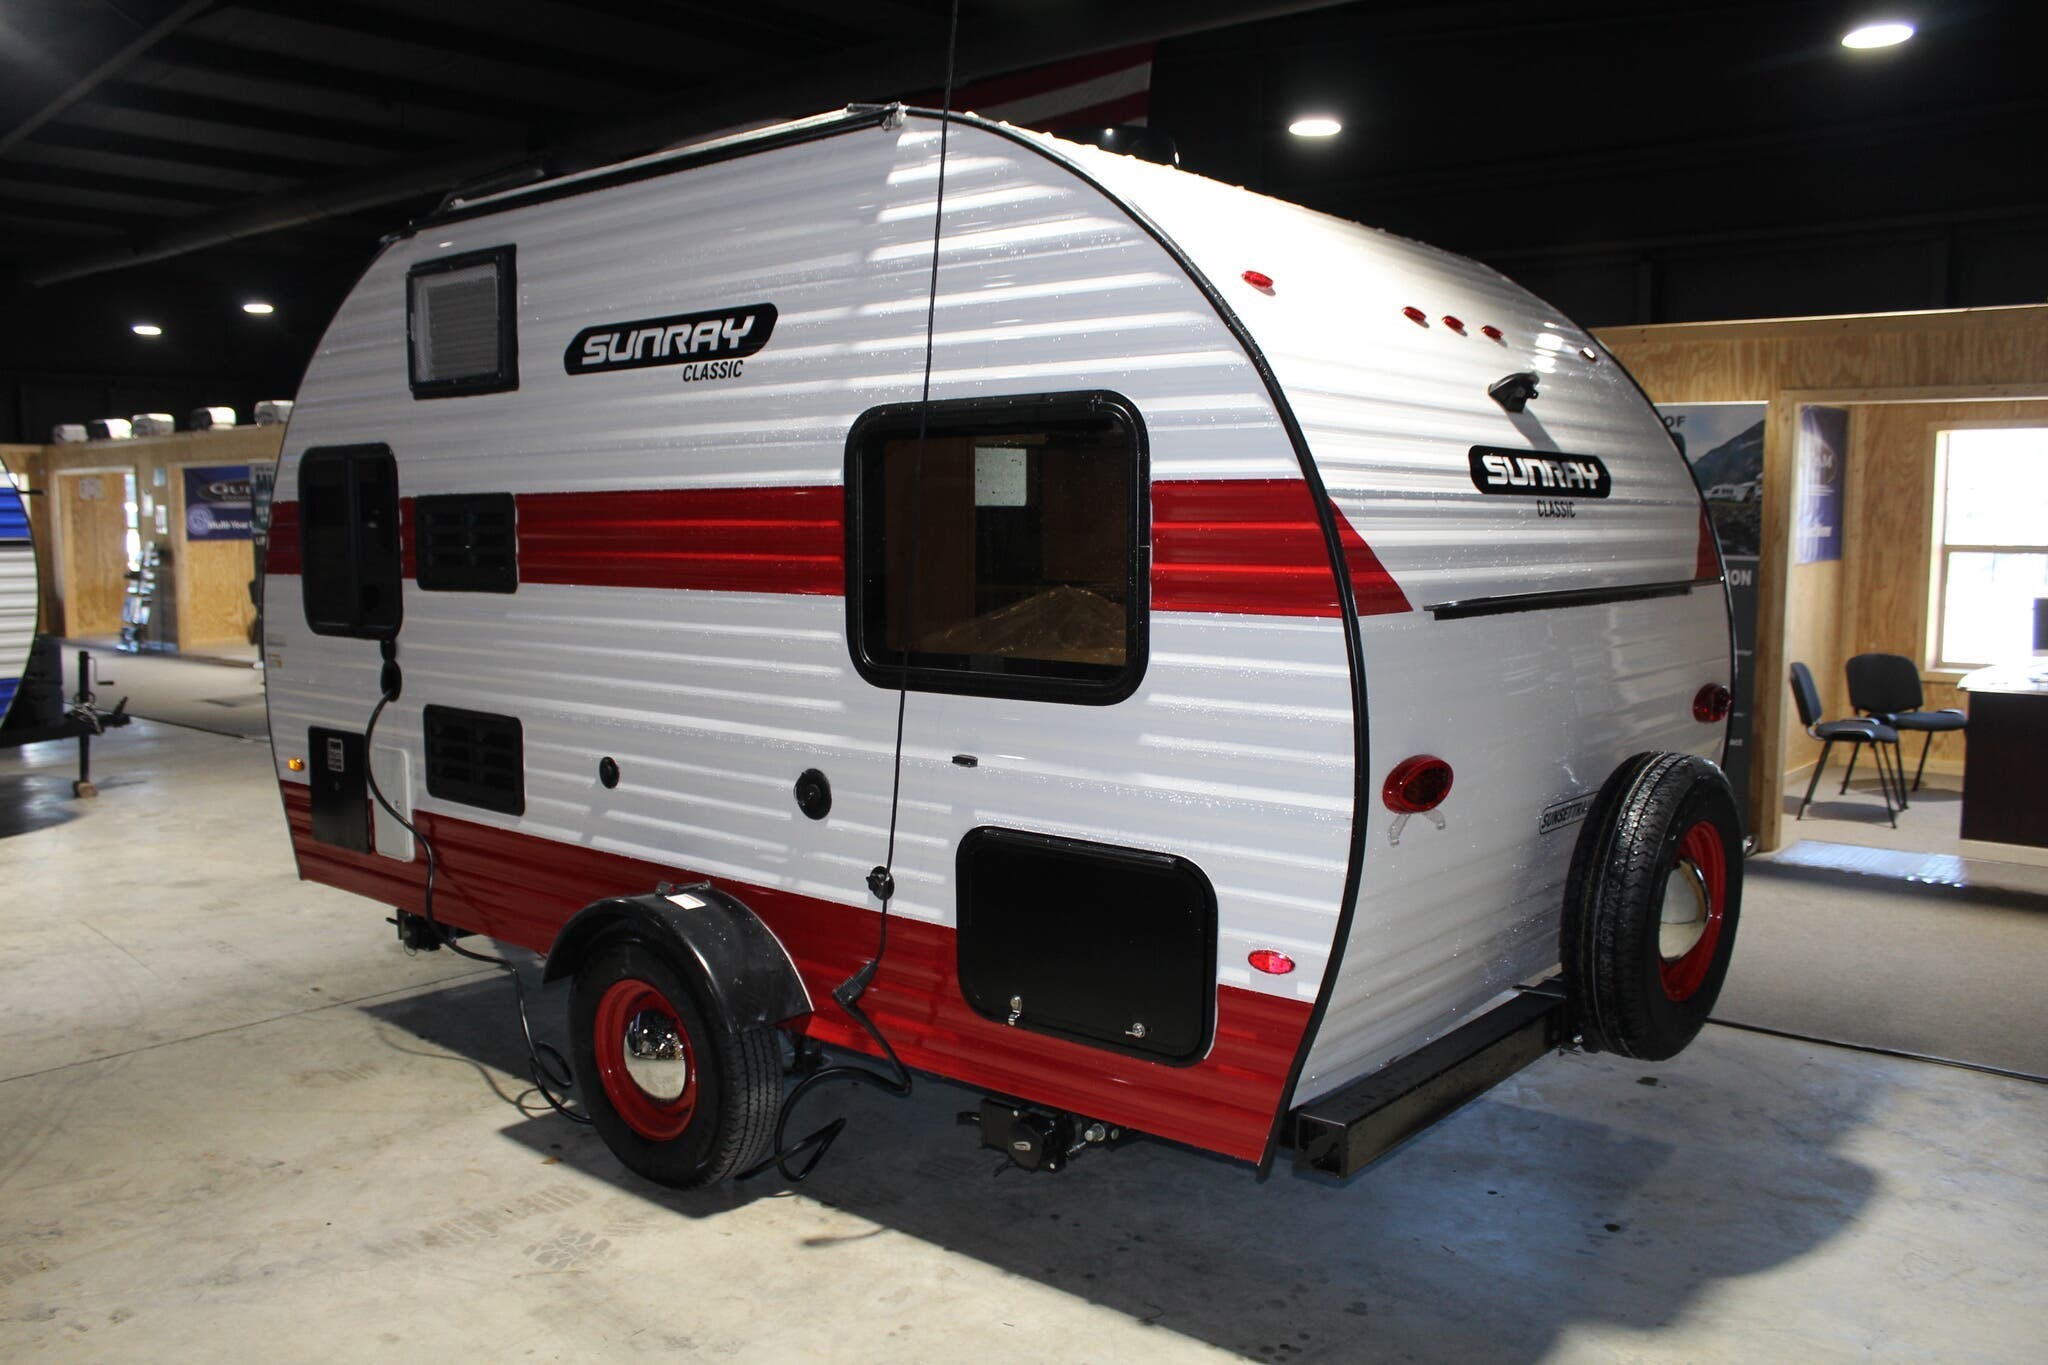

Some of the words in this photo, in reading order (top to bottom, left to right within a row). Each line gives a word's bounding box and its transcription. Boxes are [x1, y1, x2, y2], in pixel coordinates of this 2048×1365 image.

[581, 315, 756, 366] SUNRAY
[682, 359, 744, 382] CLASSIC
[1664, 415, 1686, 428] OF
[1481, 455, 1599, 490] SUNRAY
[1536, 499, 1576, 519] CLASSIC
